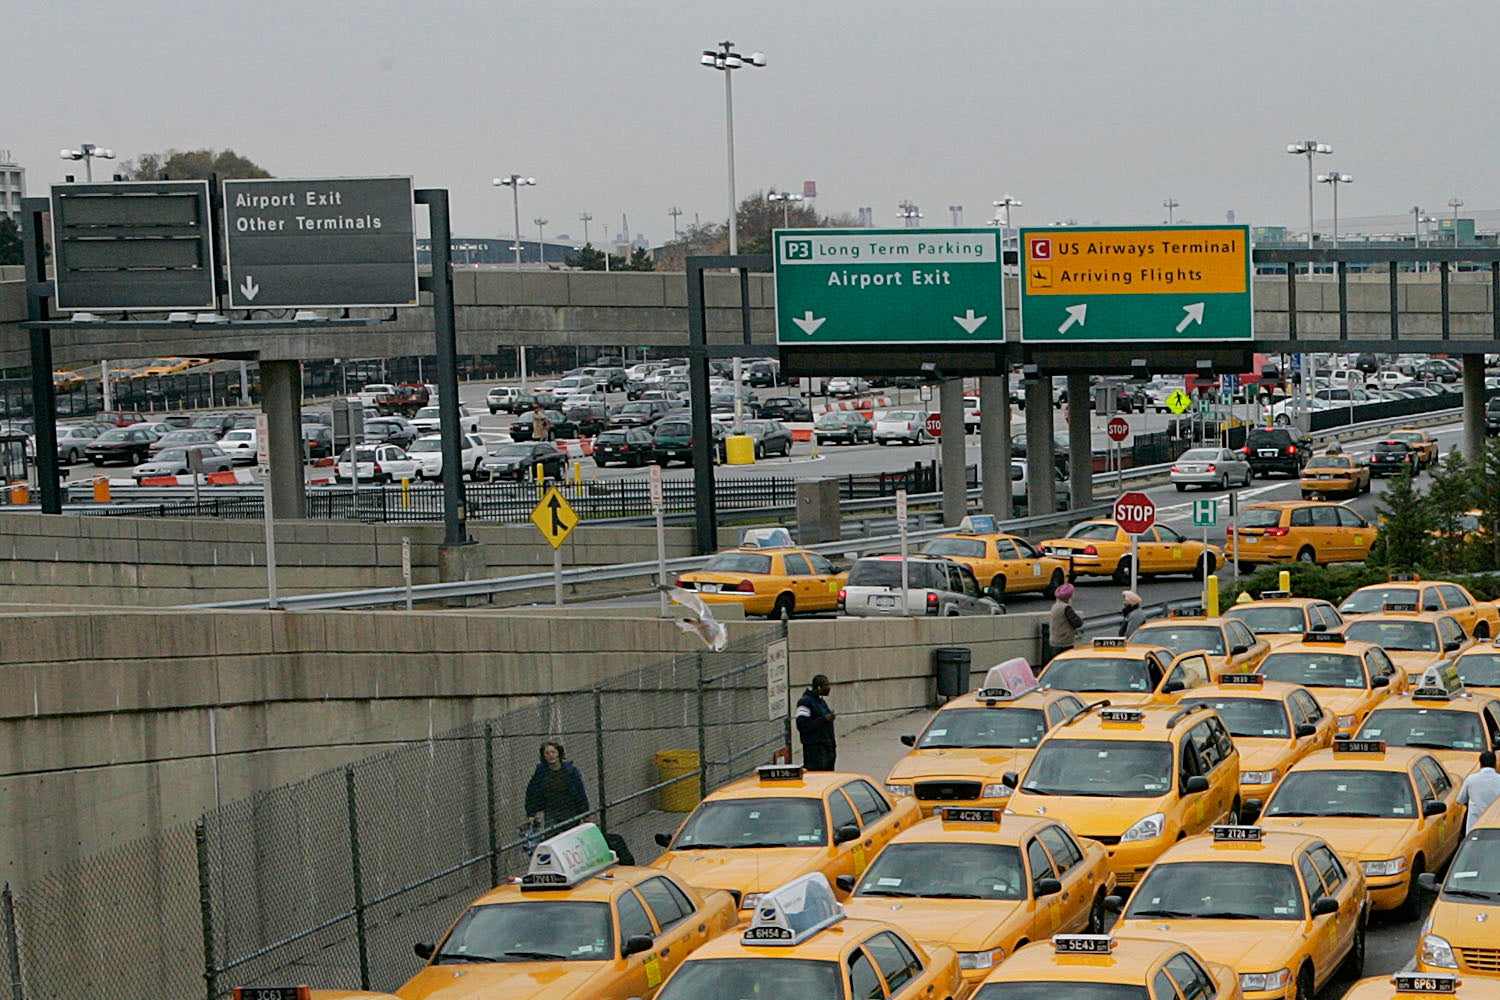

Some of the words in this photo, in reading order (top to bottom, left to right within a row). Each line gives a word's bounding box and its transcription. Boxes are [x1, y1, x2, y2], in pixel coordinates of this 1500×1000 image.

[236, 192, 295, 208] Airport
[306, 191, 342, 205] Exit
[236, 216, 285, 231] Other
[296, 214, 382, 230] Terminals
[788, 242, 809, 258] P3
[820, 244, 859, 259] Long
[869, 242, 909, 255] Term
[918, 241, 983, 256] Parking
[1035, 242, 1046, 257] C
[1058, 242, 1079, 255] US
[1087, 241, 1154, 257] Airways
[1162, 240, 1235, 254] Terminal
[828, 270, 903, 289] Airport
[912, 269, 950, 285] Exit
[1061, 269, 1132, 284] Arriving
[1140, 268, 1202, 284] Flights
[926, 421, 941, 430] STO
[1108, 424, 1128, 434] STOP
[1117, 504, 1153, 522] STOP
[1196, 500, 1214, 522] H
[959, 811, 981, 821] 4C26
[1228, 829, 1246, 838] 2T24
[756, 929, 779, 938] 6H54
[1069, 940, 1095, 950] 5E43
[1414, 979, 1437, 989] 6P63
[257, 990, 282, 1000] 3C63
